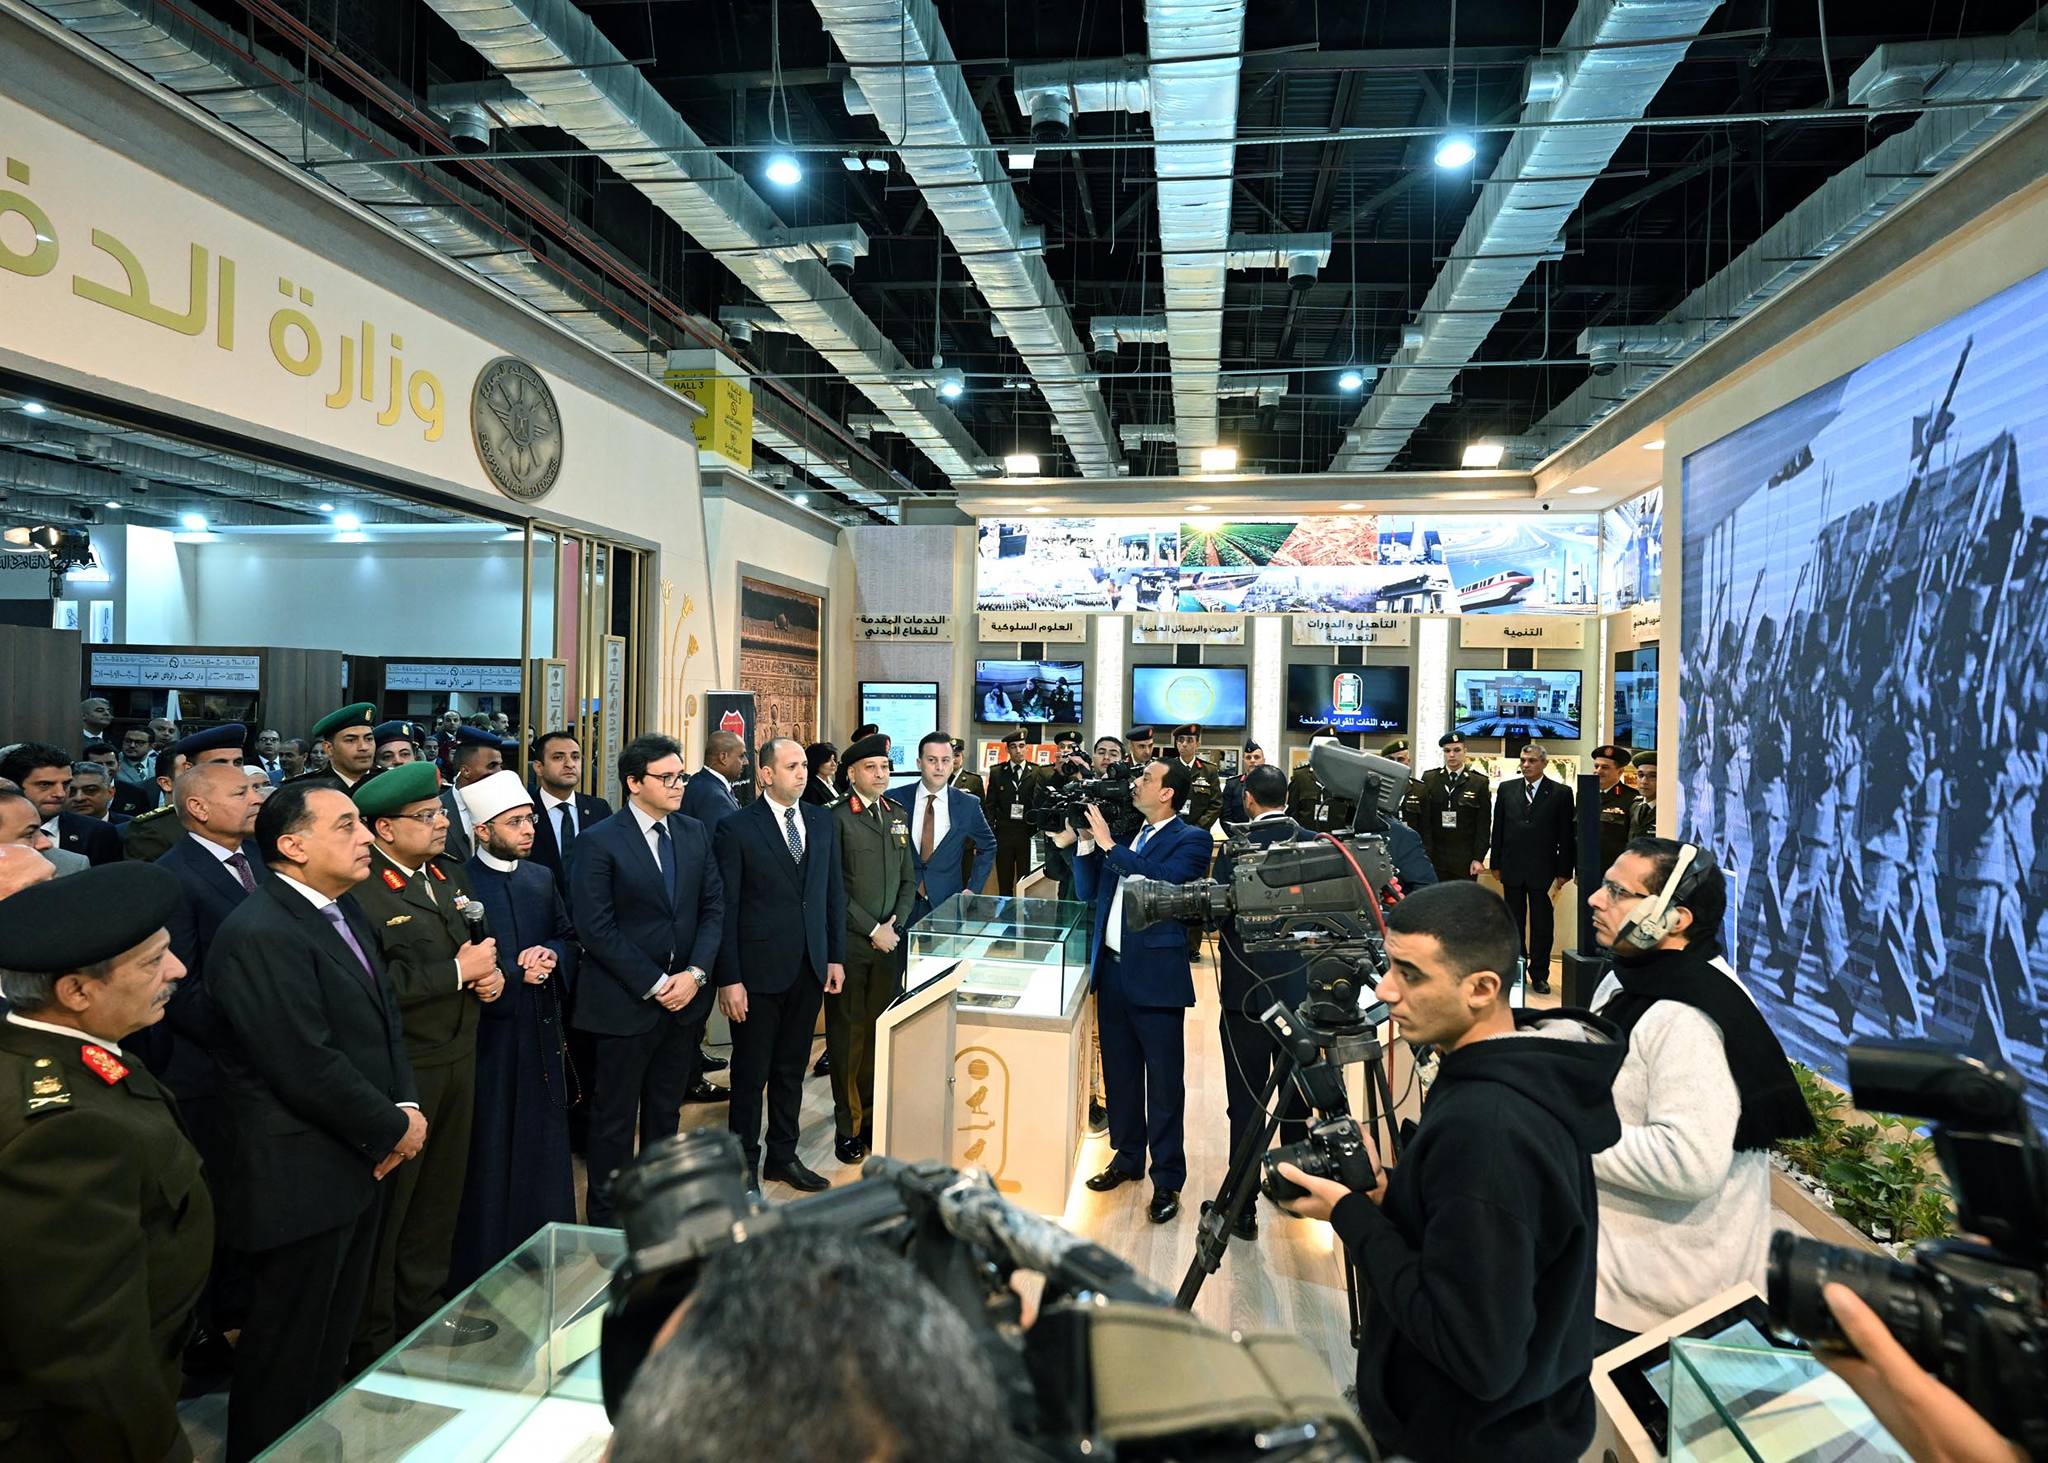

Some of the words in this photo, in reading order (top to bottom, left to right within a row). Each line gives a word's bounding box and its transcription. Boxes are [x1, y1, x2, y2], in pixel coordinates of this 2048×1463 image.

[0, 157, 235, 351] الدف
[269, 276, 444, 442] وزارة
[674, 382, 697, 390] HALL
[698, 382, 705, 390] 3
[860, 614, 901, 625] المقدمة
[903, 615, 946, 625] الخدمات
[1307, 619, 1345, 630] الدورات
[1355, 618, 1397, 630] التأهيل
[902, 626, 939, 637] للقطاع
[991, 621, 1037, 633] السلوكية
[1038, 622, 1073, 632] العلوم
[1171, 624, 1208, 634] والرسائل
[1209, 624, 1239, 634] البحوث
[1347, 622, 1353, 630] و
[864, 626, 900, 640] المدني
[1503, 626, 1543, 638] التنمية
[1326, 633, 1378, 644] التعليمية
[1299, 715, 1328, 726] المسلحة
[1330, 717, 1354, 728] للقوات
